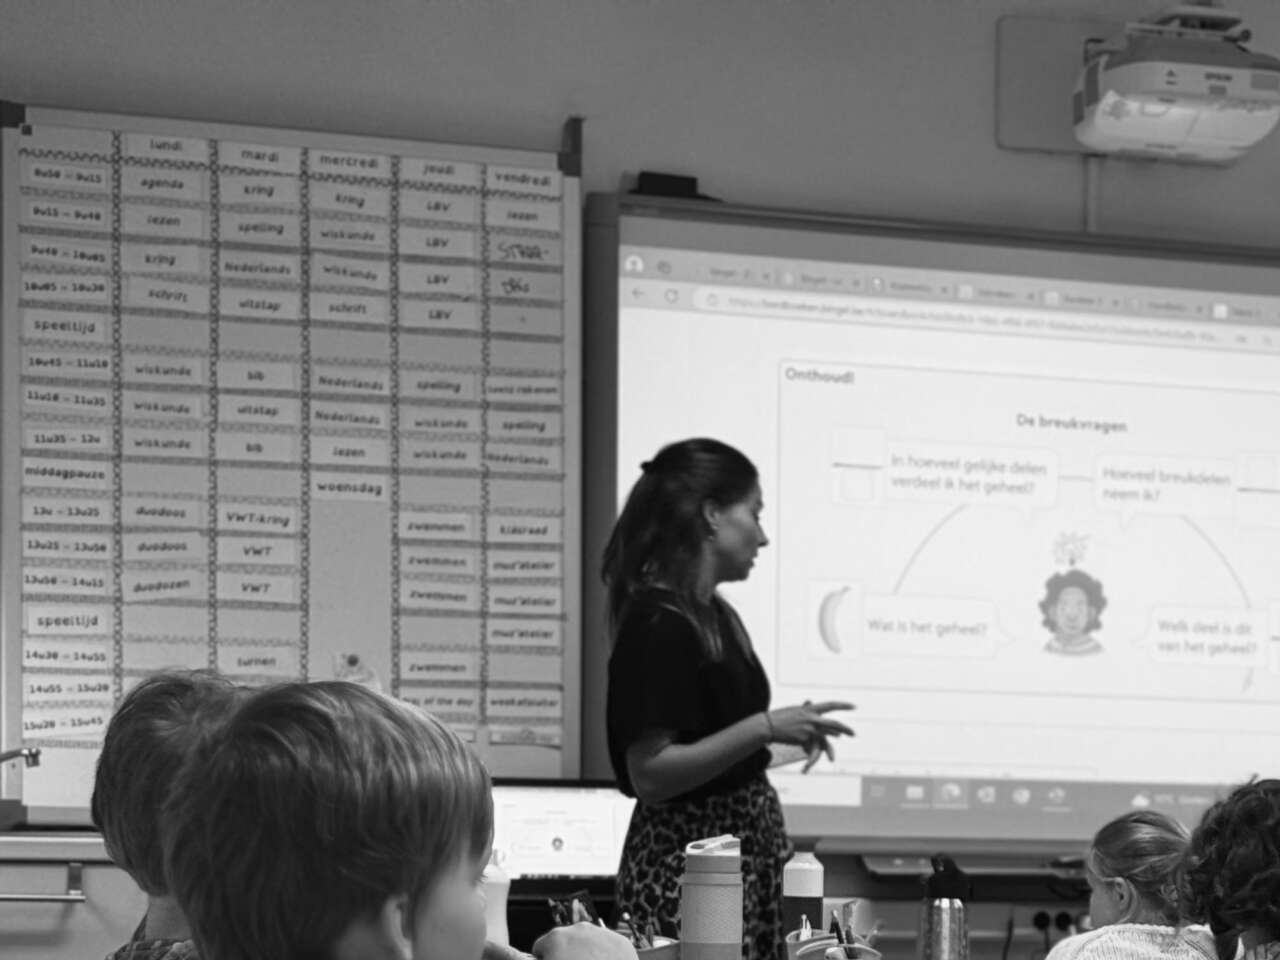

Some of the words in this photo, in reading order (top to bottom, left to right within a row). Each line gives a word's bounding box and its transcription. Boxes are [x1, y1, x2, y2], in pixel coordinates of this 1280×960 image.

[150, 140, 183, 152] lundi
[241, 150, 280, 163] mardi
[320, 155, 378, 169] mercredi
[423, 163, 454, 177] jeudi
[495, 172, 551, 187] vendredi
[244, 185, 275, 198] kring
[335, 192, 366, 209] kring
[320, 230, 376, 242] wiskunde
[144, 254, 176, 267] kring
[224, 262, 291, 275] Nederlands
[323, 265, 378, 282] wiskunde
[148, 288, 188, 304] schrift
[328, 302, 367, 315] schrift
[34, 320, 95, 336] speeltijd
[135, 365, 192, 378] wiskunde
[318, 375, 383, 391] Nederlands
[133, 400, 191, 415] wiskunde
[315, 410, 380, 426] Nederlands
[414, 418, 468, 430] wiskunde
[1016, 413, 1034, 428] De
[1038, 414, 1128, 436] breukvragen
[134, 438, 191, 451] wiskunde
[413, 450, 467, 461] wiskunde
[24, 465, 105, 482] middagpauze
[908, 456, 961, 471] hoeveel
[964, 458, 1007, 477] gelijke
[1010, 461, 1048, 476] delen
[1102, 467, 1156, 483] Hoeveel
[1158, 469, 1232, 486] breukdelen
[316, 482, 382, 498] woensdag
[891, 474, 942, 489] verdeel
[959, 477, 981, 492] het
[984, 479, 1036, 496] geheel?
[1102, 488, 1139, 500] neem
[37, 614, 99, 629] speeltijd
[866, 619, 894, 633] Wat
[910, 621, 932, 634] het
[936, 622, 987, 639] geheel?
